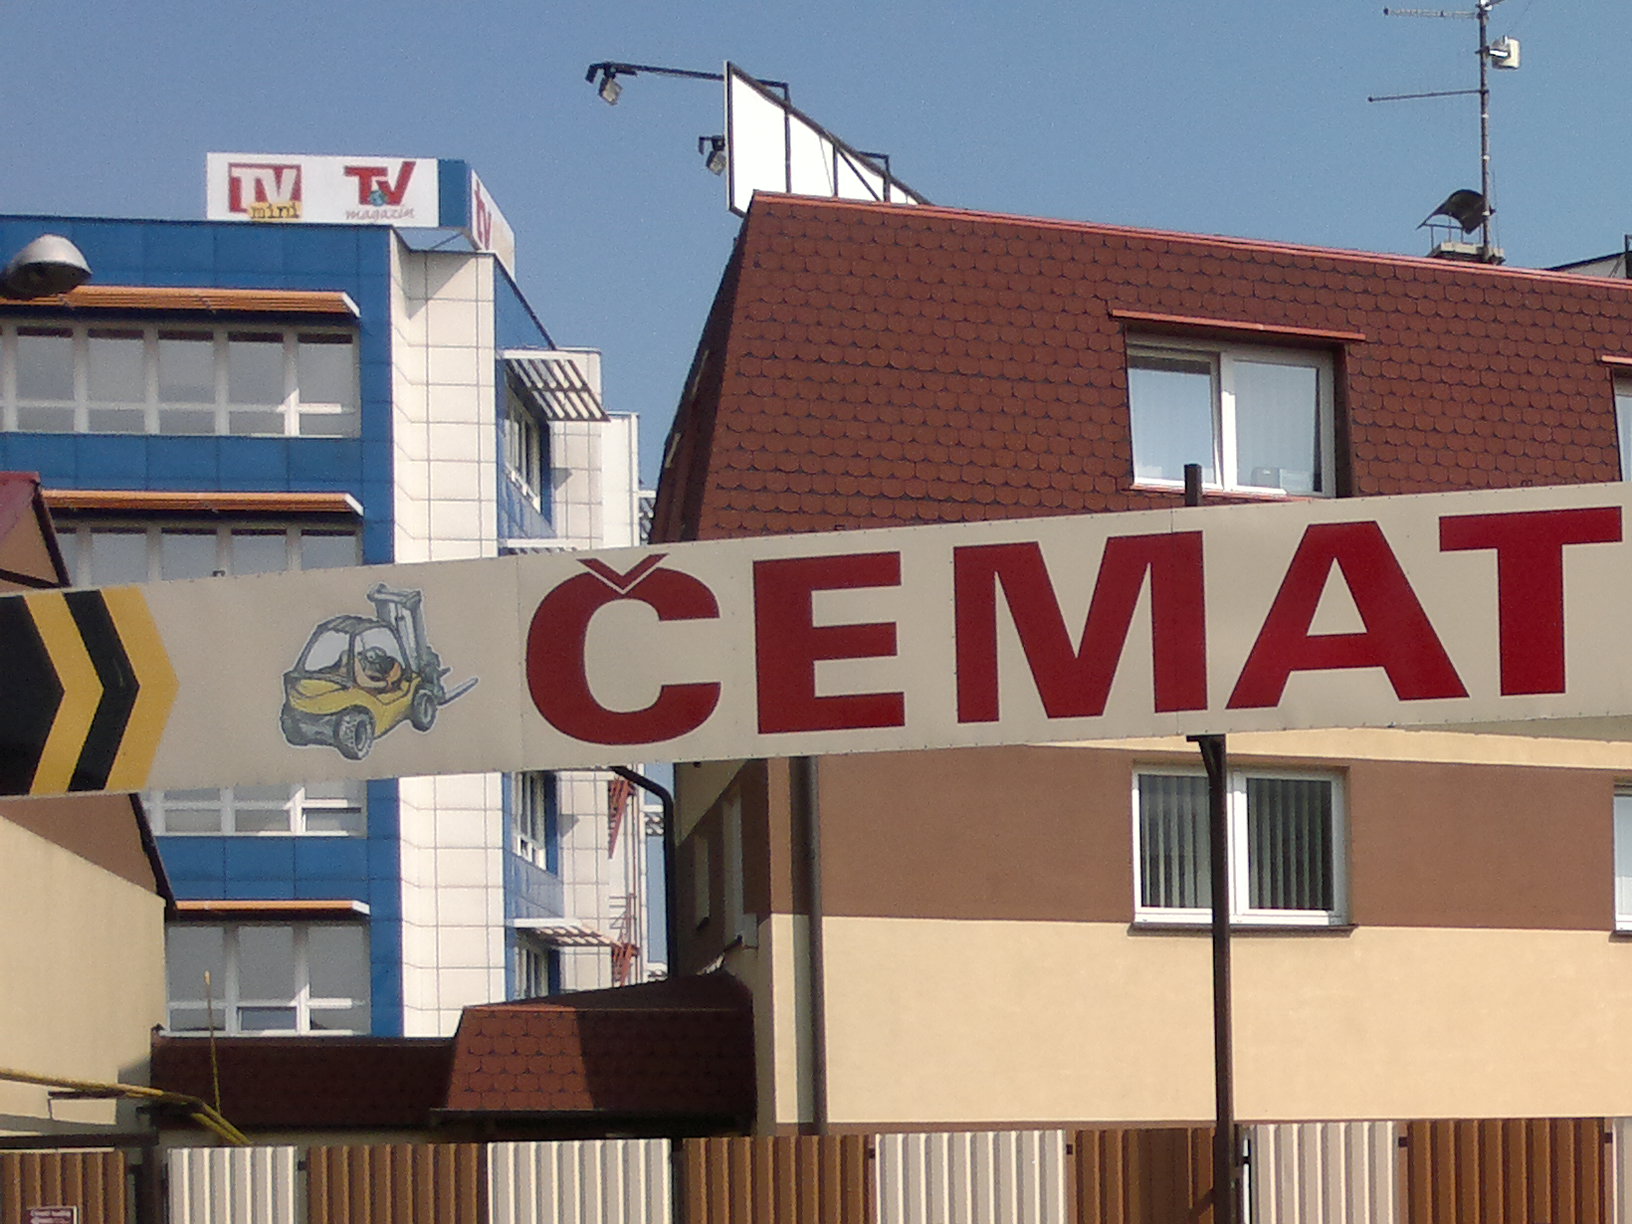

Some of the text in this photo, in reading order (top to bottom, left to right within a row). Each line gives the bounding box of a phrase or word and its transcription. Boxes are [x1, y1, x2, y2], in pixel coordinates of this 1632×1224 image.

[231, 166, 298, 211] TV
[344, 161, 416, 206] TV
[250, 201, 300, 219] mini
[525, 505, 1623, 745] ČEMAT
